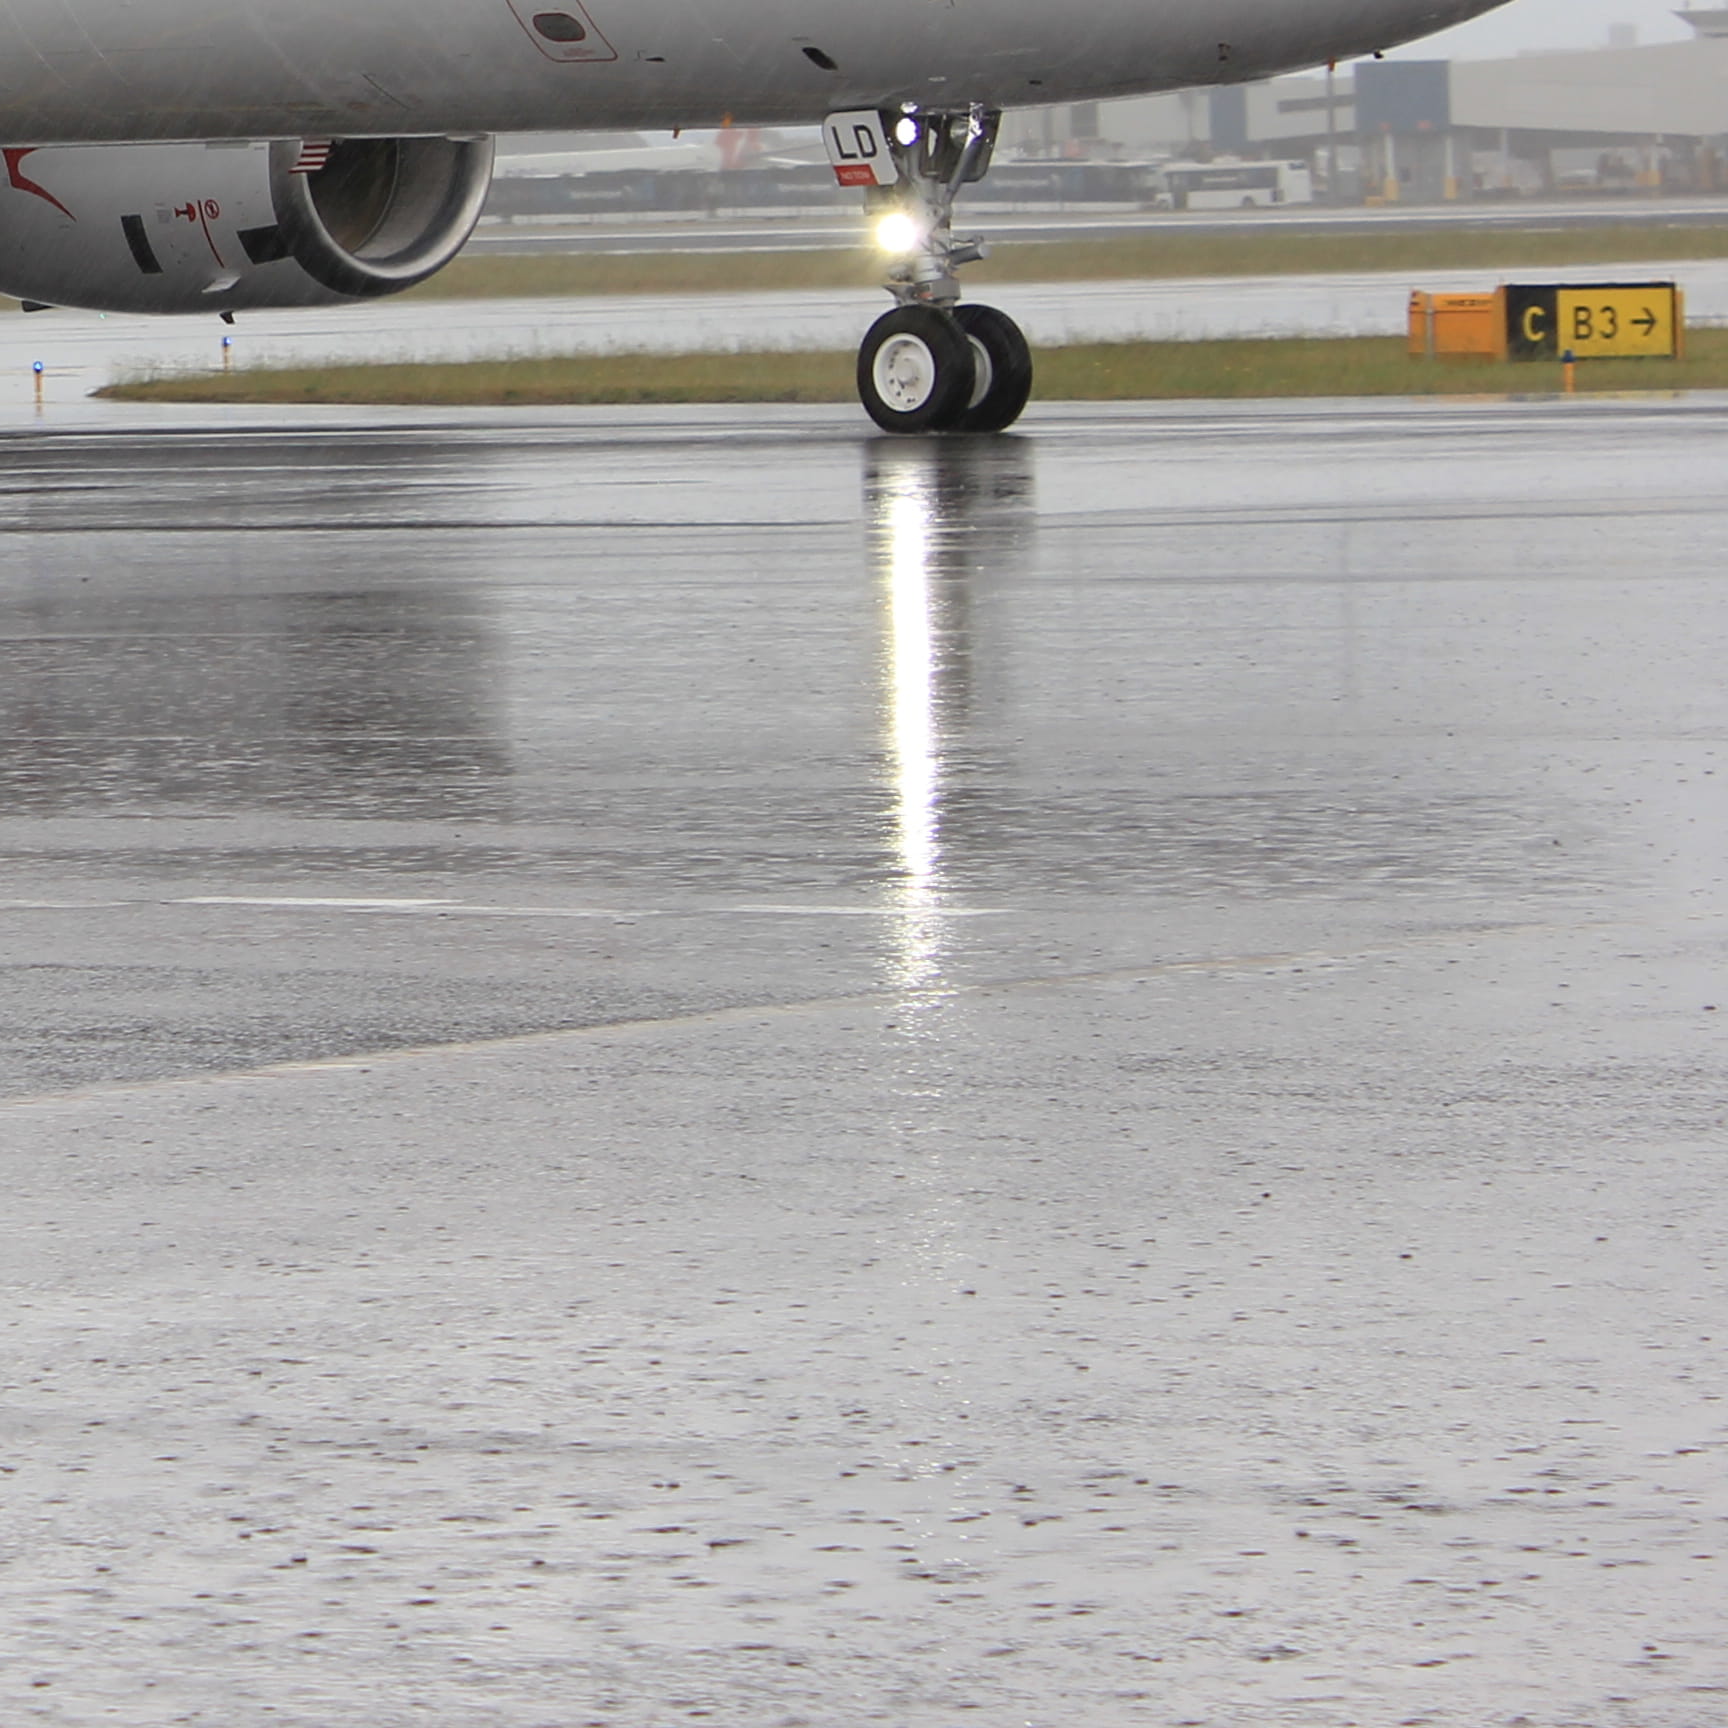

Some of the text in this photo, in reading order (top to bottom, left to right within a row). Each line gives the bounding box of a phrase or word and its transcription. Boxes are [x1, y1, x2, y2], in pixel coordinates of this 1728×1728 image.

[831, 124, 878, 160] LD
[1524, 305, 1545, 342] C
[1573, 305, 1618, 340] B3
